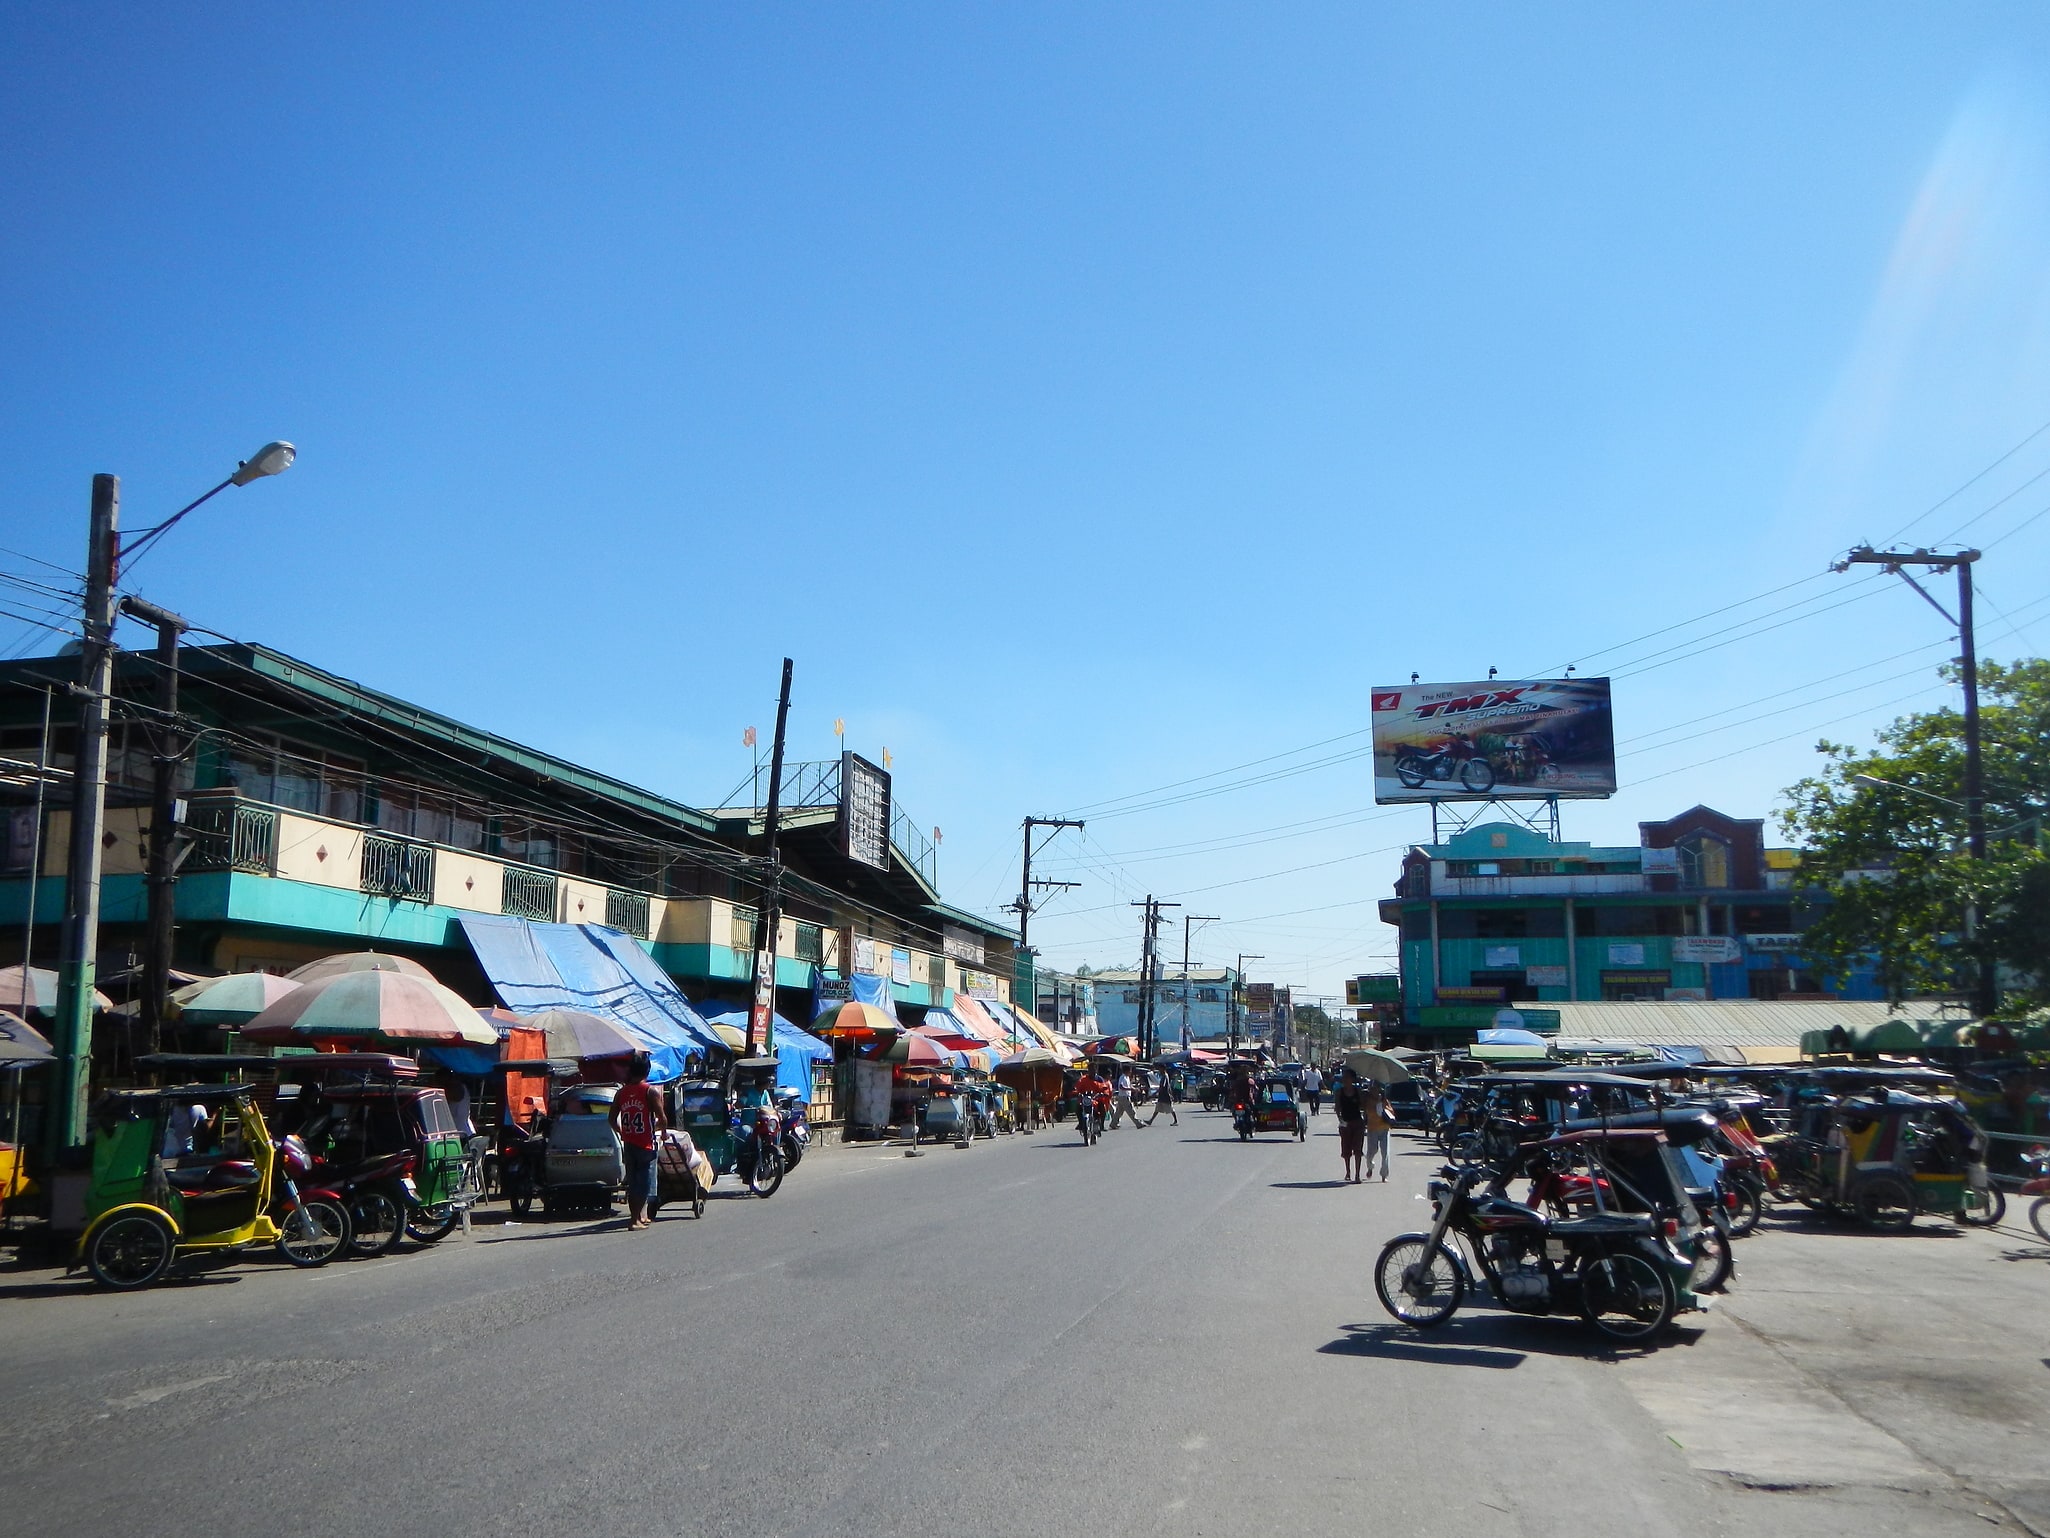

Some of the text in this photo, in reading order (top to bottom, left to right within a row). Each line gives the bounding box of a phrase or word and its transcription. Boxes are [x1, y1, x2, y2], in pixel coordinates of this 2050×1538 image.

[1413, 687, 1530, 720] TMX
[1421, 691, 1453, 702] The NEW
[1466, 703, 1540, 721] SUPREMO
[622, 1111, 645, 1134] 44
